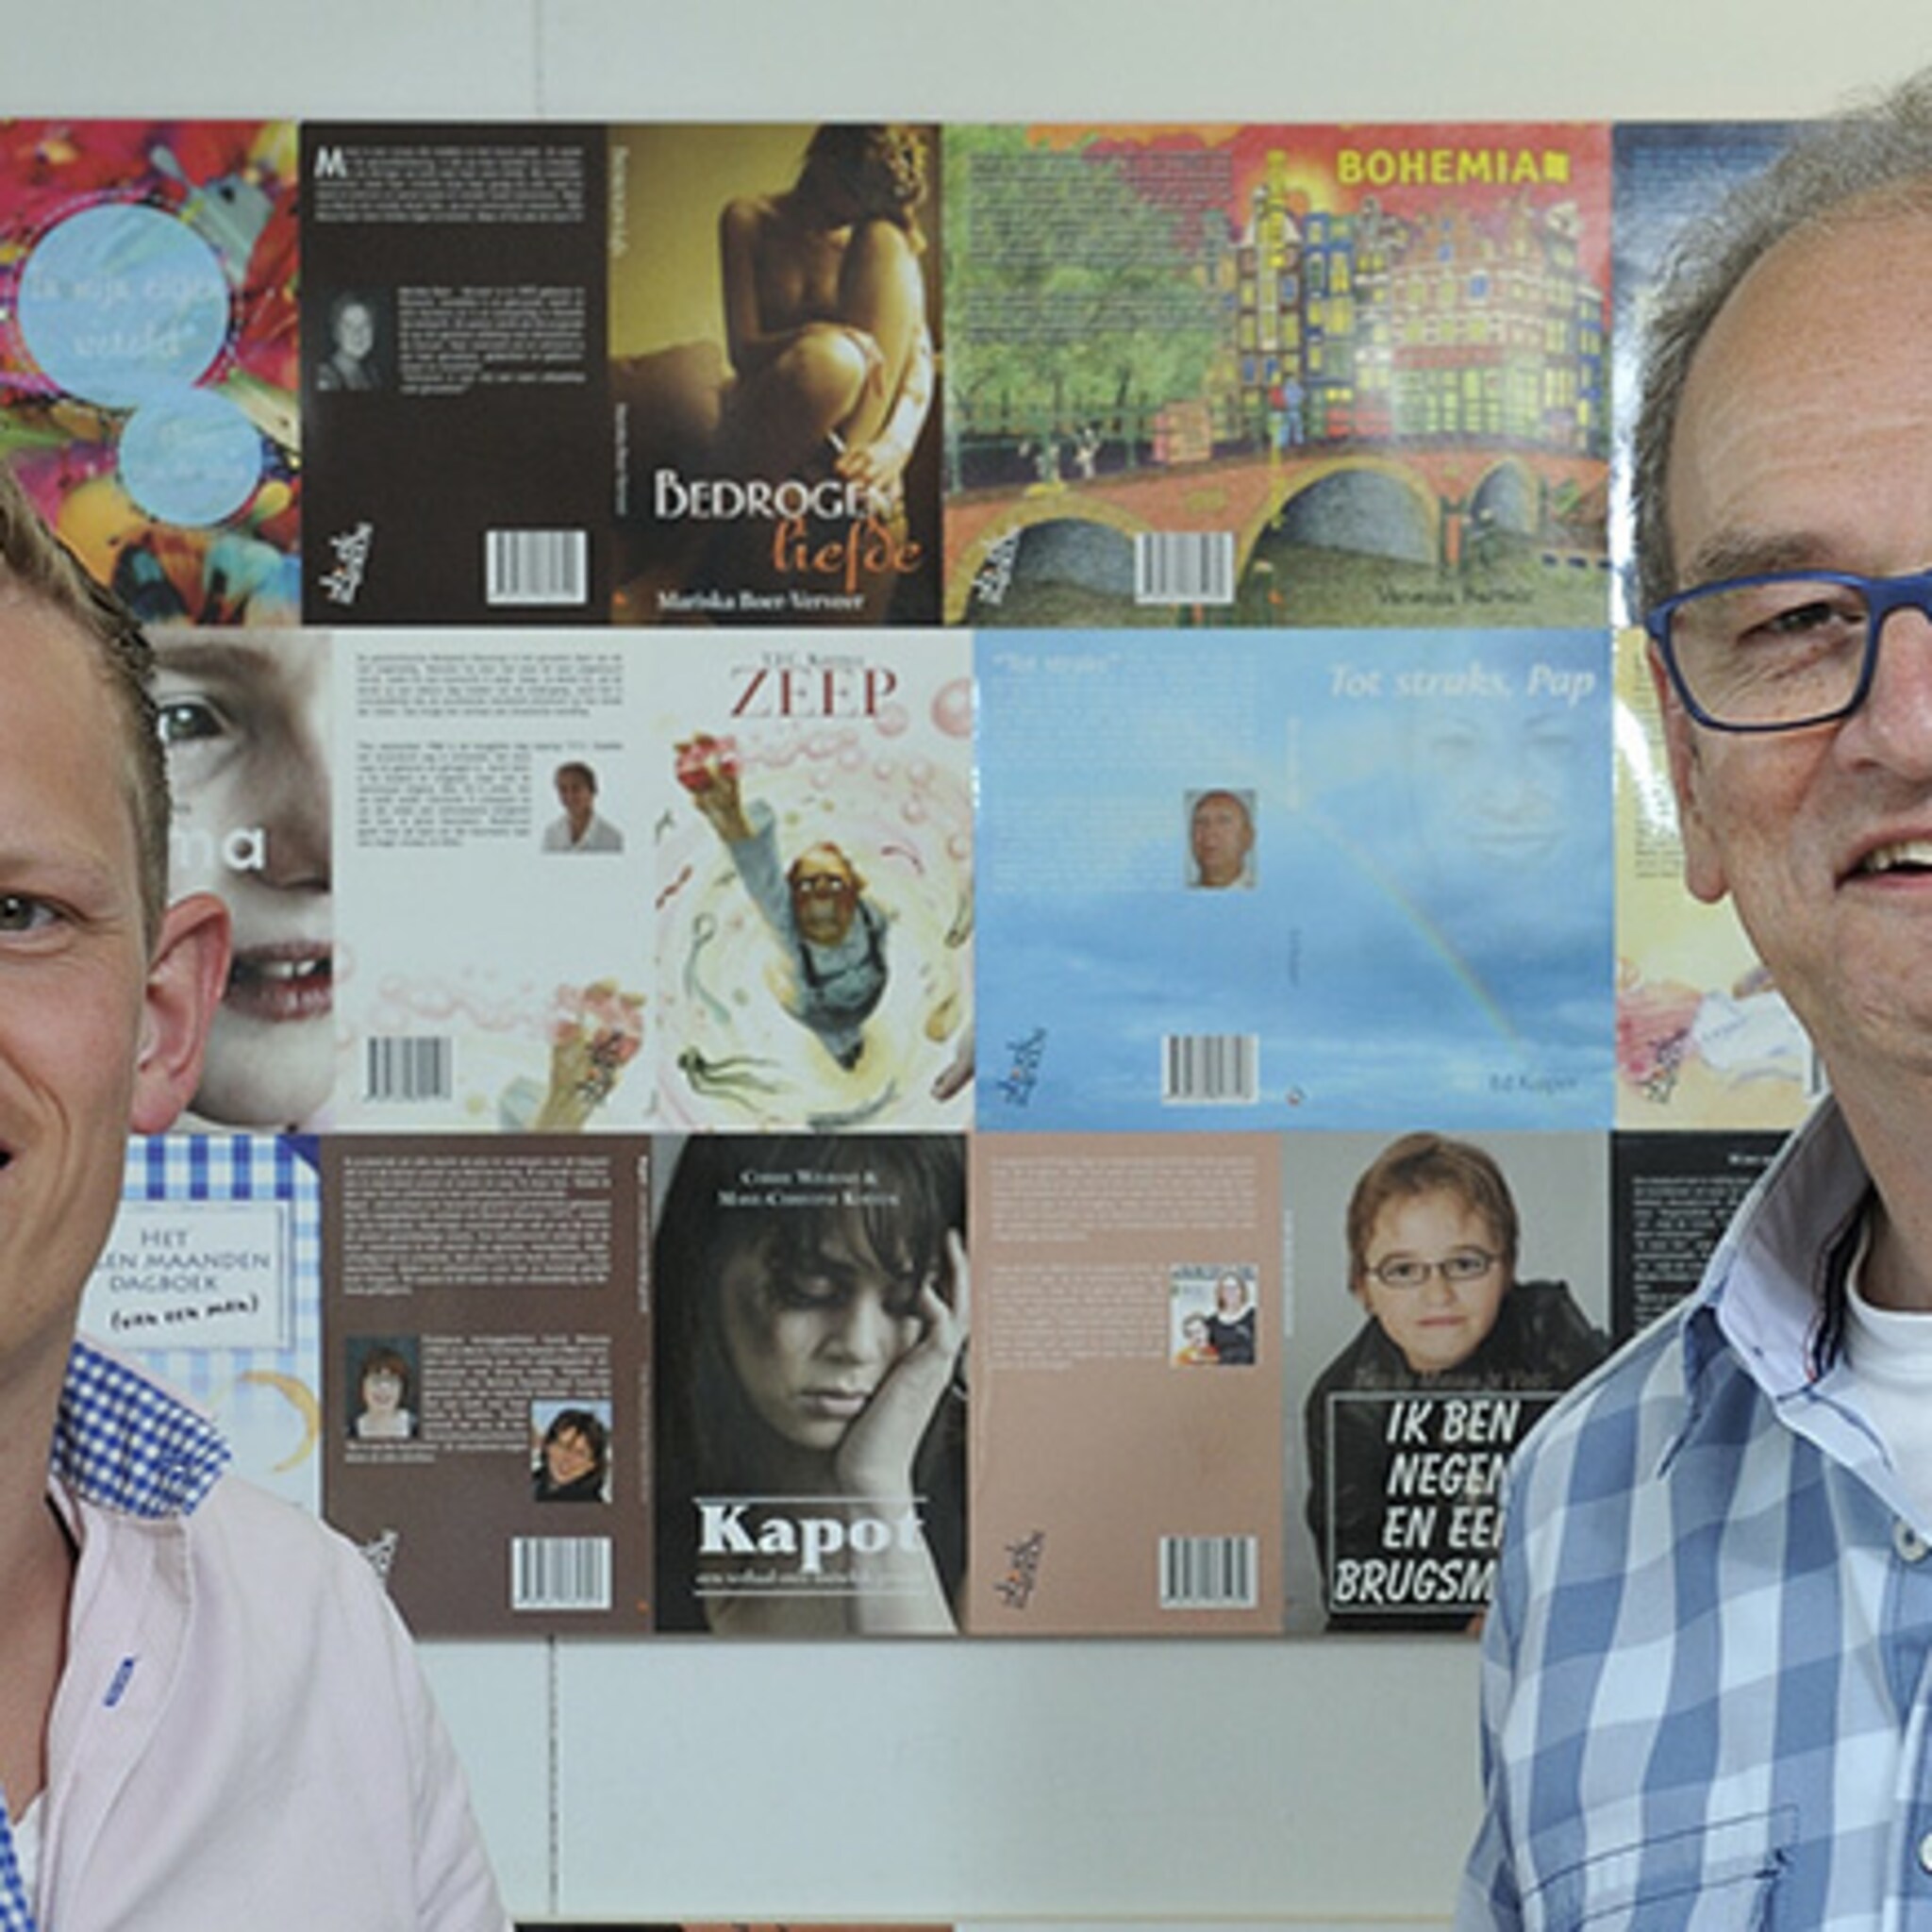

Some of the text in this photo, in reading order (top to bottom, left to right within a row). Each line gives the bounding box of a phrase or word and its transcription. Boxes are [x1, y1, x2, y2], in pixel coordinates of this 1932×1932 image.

[773, 517, 923, 592] liefde
[730, 664, 897, 717] ZEEP
[1330, 663, 1382, 696] Tot
[1527, 663, 1596, 708] Pap
[142, 1229, 188, 1247] HET
[143, 1253, 271, 1270] MAANDEN
[109, 1275, 217, 1293] DAGBOEK
[1386, 1400, 1522, 1444] IK BEN
[698, 1505, 925, 1574] Kapot
[1382, 1506, 1437, 1549] EN
